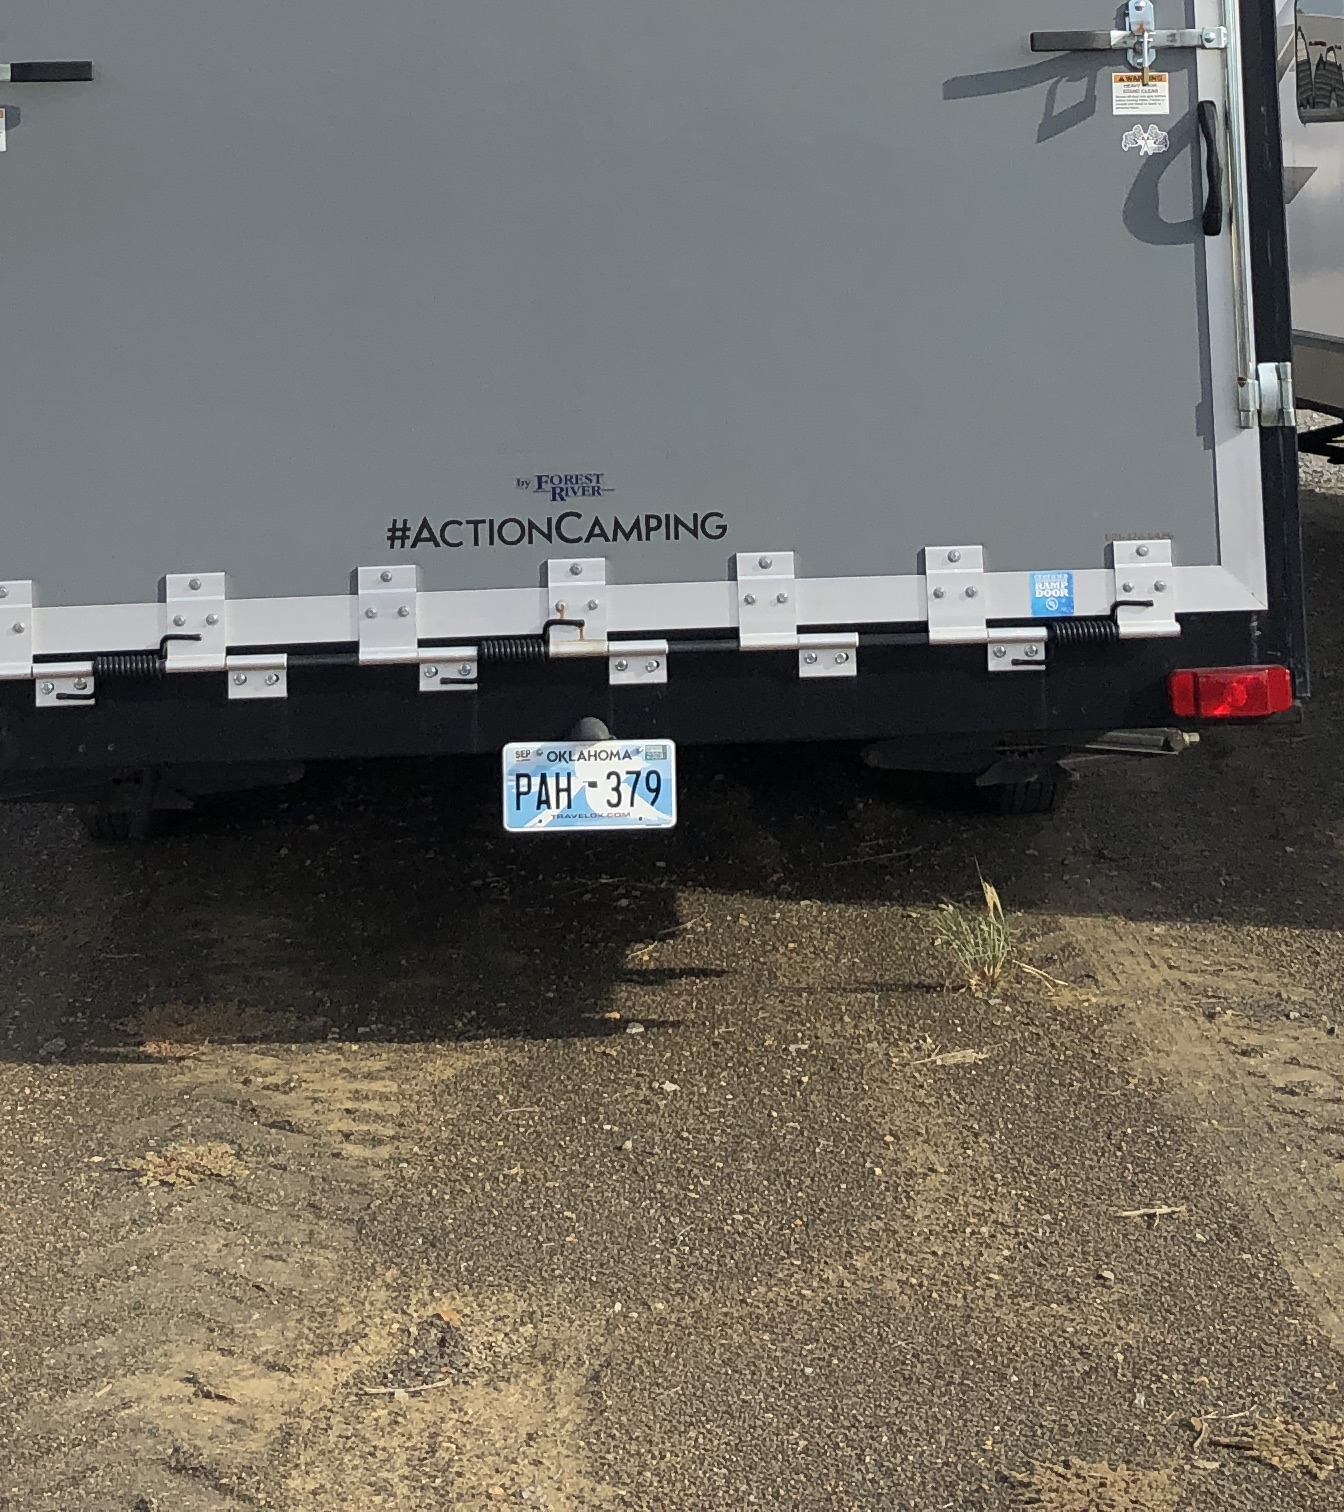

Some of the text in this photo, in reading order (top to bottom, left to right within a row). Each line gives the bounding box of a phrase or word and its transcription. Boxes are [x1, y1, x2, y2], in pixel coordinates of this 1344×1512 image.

[516, 472, 604, 492] by FOREST
[550, 485, 602, 502] RIVER
[1035, 589, 1069, 597] DOOR
[515, 749, 531, 760] SEP
[546, 749, 633, 764] OKLAHOMA
[550, 812, 631, 820] TRAVELOK.COM
